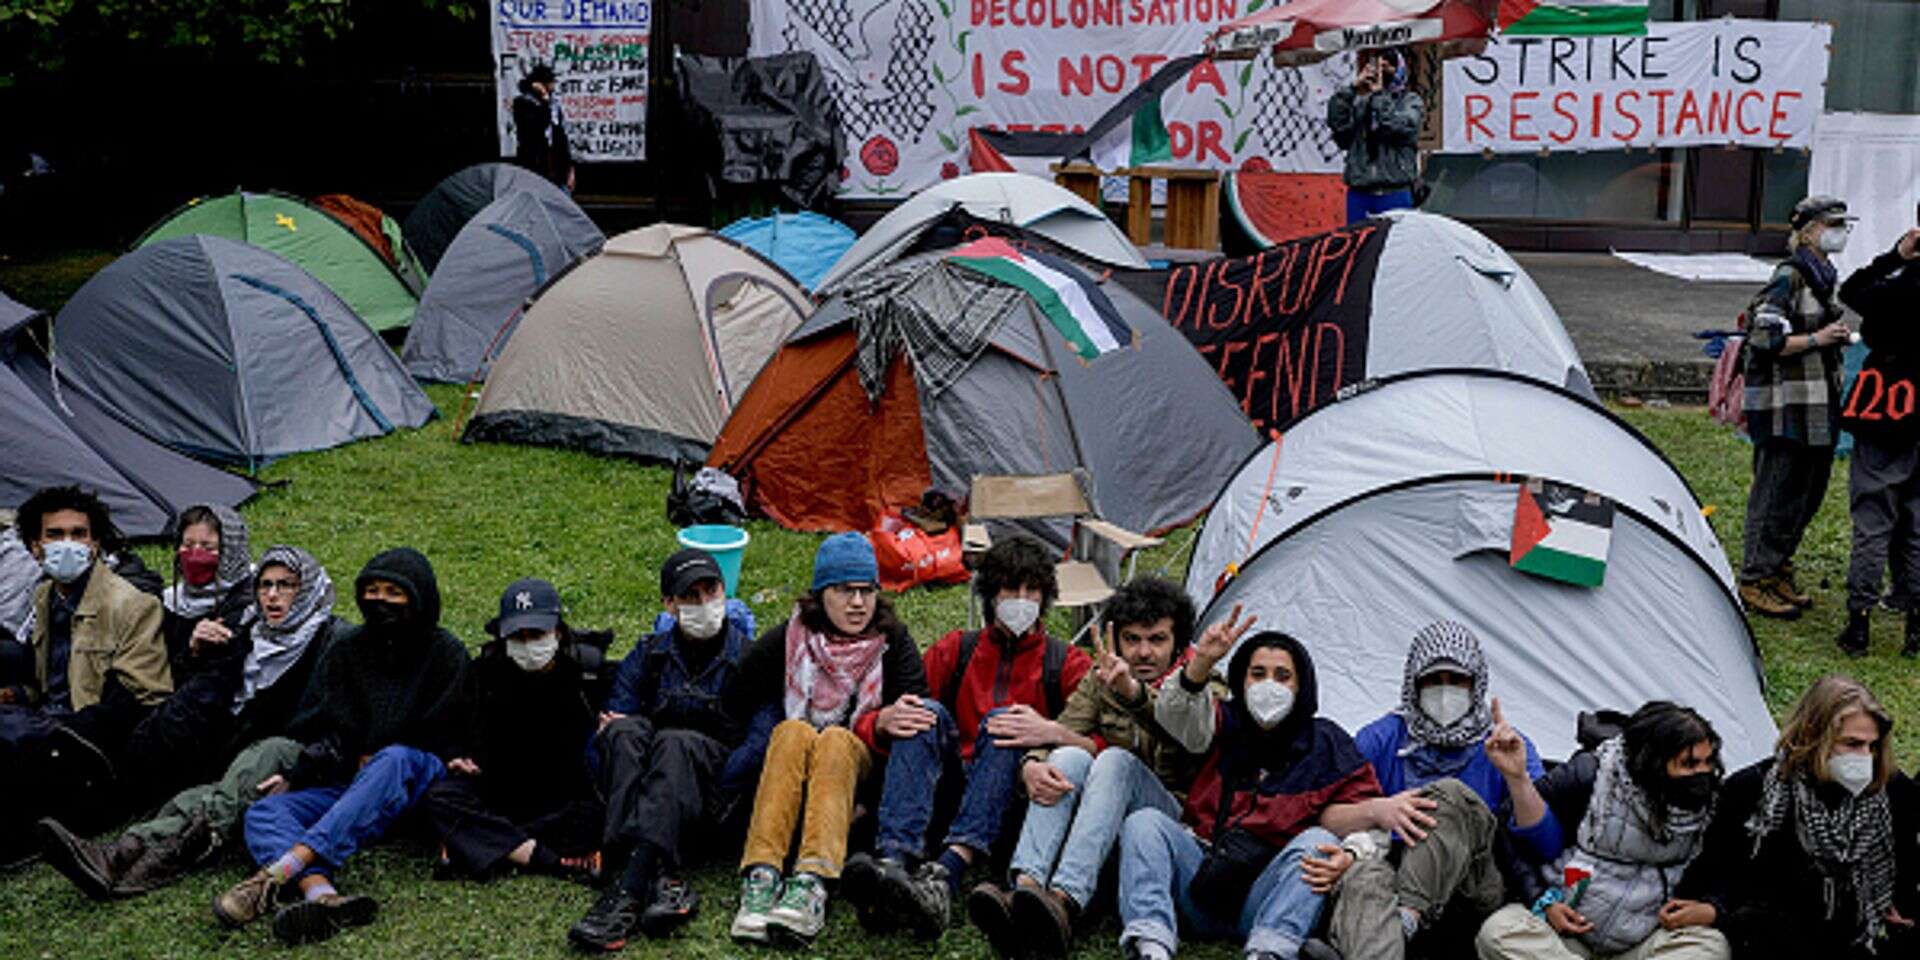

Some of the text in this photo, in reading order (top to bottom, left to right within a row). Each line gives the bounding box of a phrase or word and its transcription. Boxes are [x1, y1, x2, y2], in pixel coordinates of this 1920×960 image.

[500, 0, 546, 20] OUR
[970, 0, 1237, 29] DECOLONISATION
[971, 50, 1227, 99] IS NOT A
[1462, 35, 1762, 85] STRIKE IS
[1464, 89, 1802, 144] RESISTANCE
[1162, 226, 1377, 330] DISRUPT
